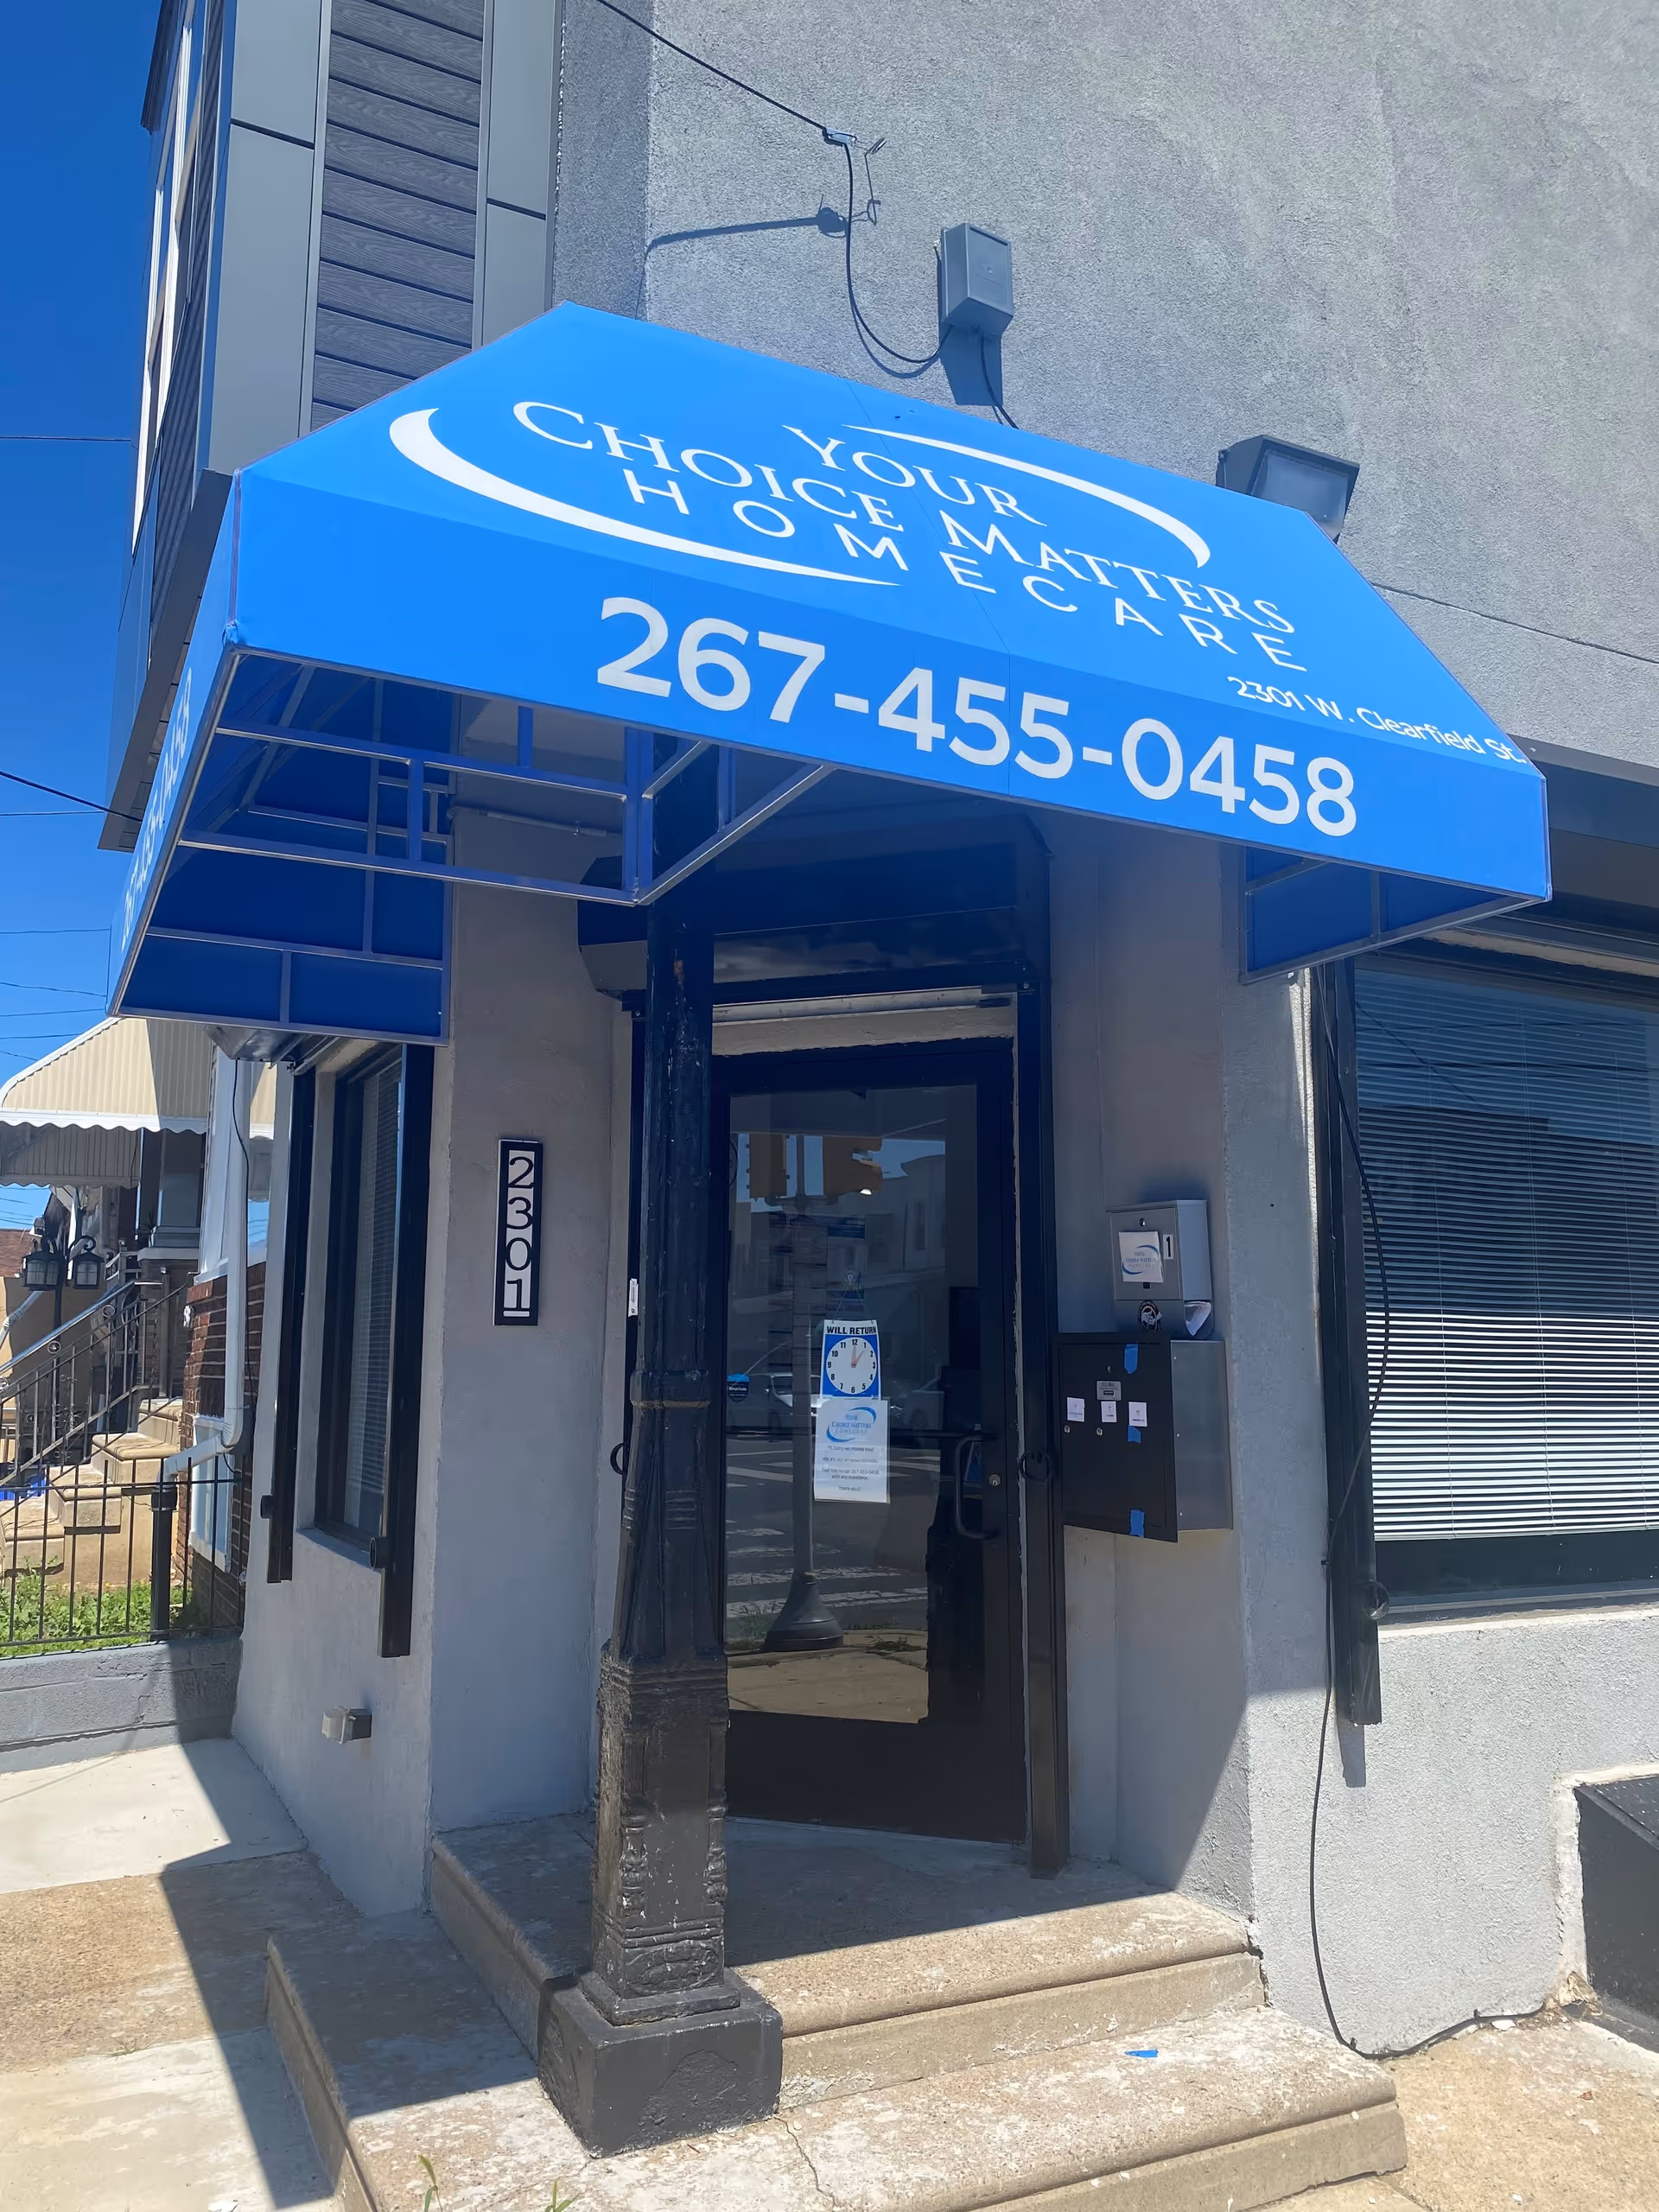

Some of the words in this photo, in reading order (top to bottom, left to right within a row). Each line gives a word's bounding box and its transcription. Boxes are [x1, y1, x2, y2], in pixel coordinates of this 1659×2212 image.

[513, 402, 904, 532] CHOICE
[940, 492, 1295, 634] MATTERS
[783, 425, 1046, 527] YOUR
[597, 596, 1357, 837] 267-455-0458
[1227, 676, 1306, 711] 2301
[1356, 707, 1486, 755] Clearfield
[1484, 738, 1527, 764] St.
[504, 1156, 534, 1312] 2301
[1166, 1236, 1172, 1258] 1
